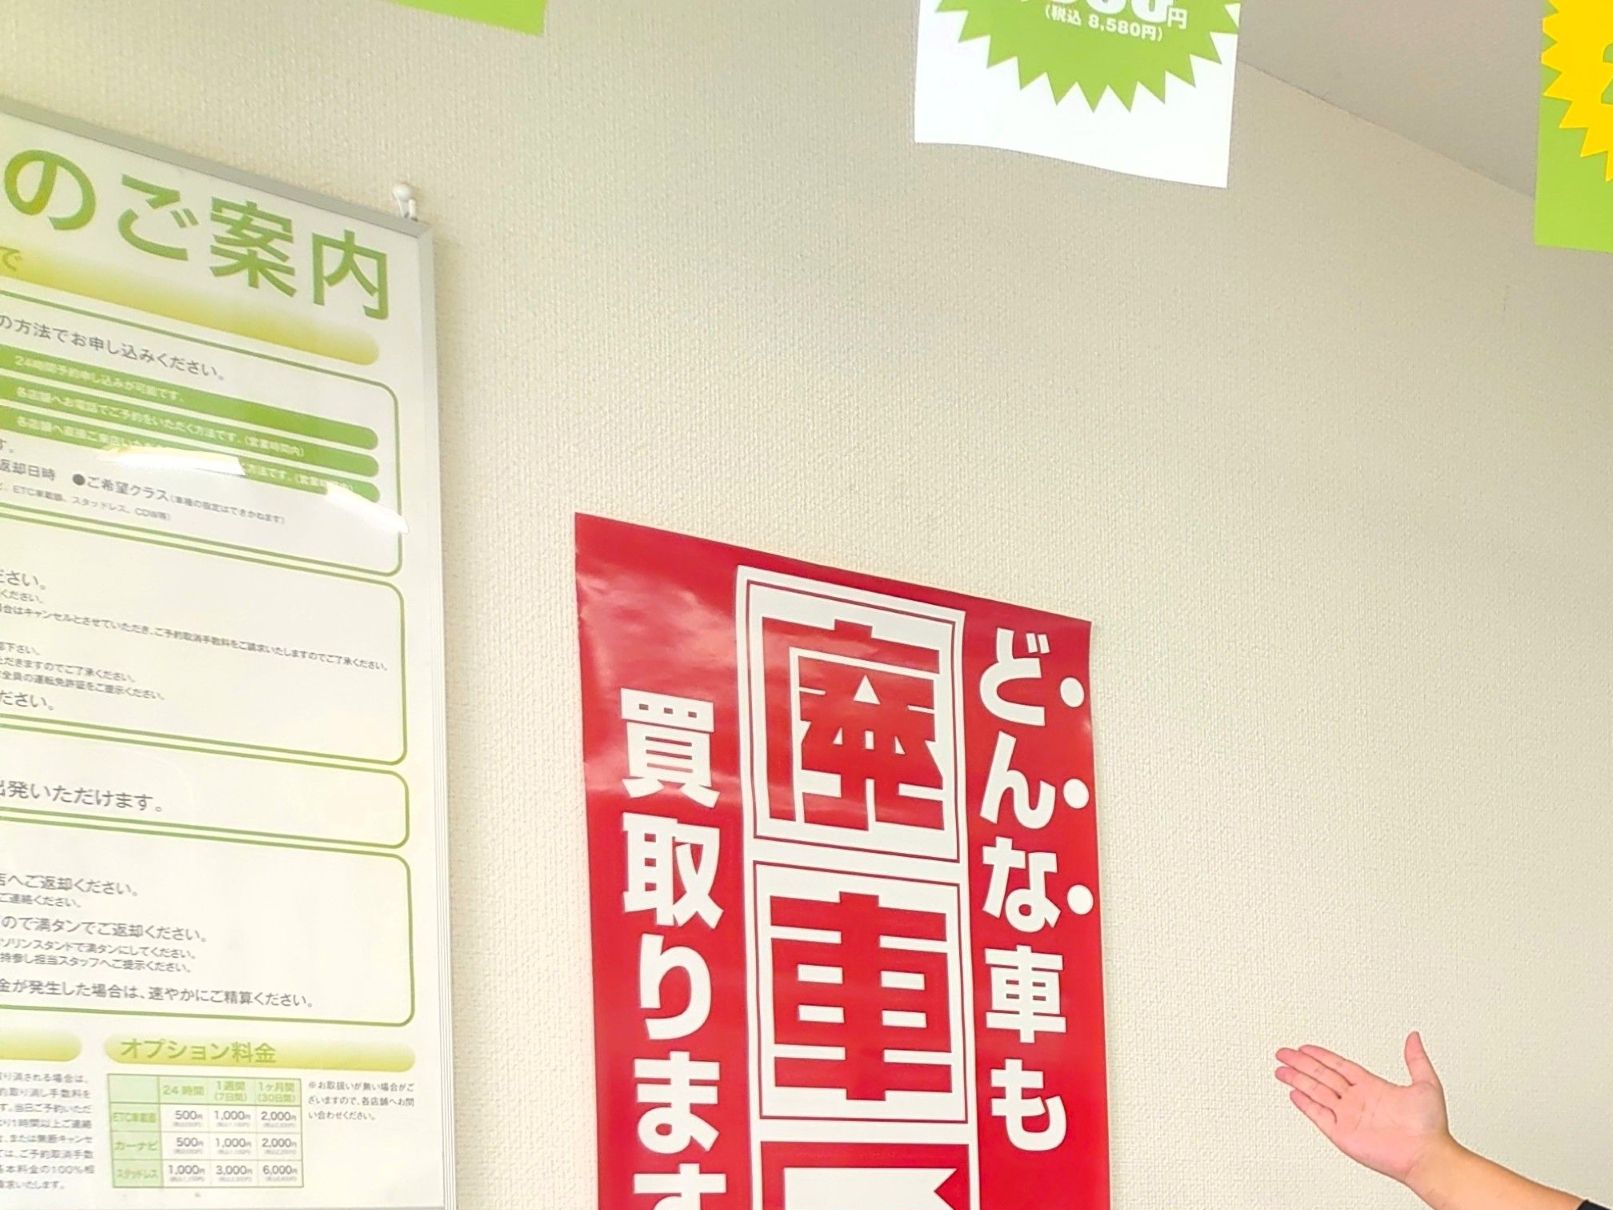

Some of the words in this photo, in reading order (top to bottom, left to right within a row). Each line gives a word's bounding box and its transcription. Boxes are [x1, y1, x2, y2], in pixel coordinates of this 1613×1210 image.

[3, 149, 391, 321] のご案内
[977, 625, 1067, 1154] どんな車も
[120, 1038, 277, 1064] オプション料金
